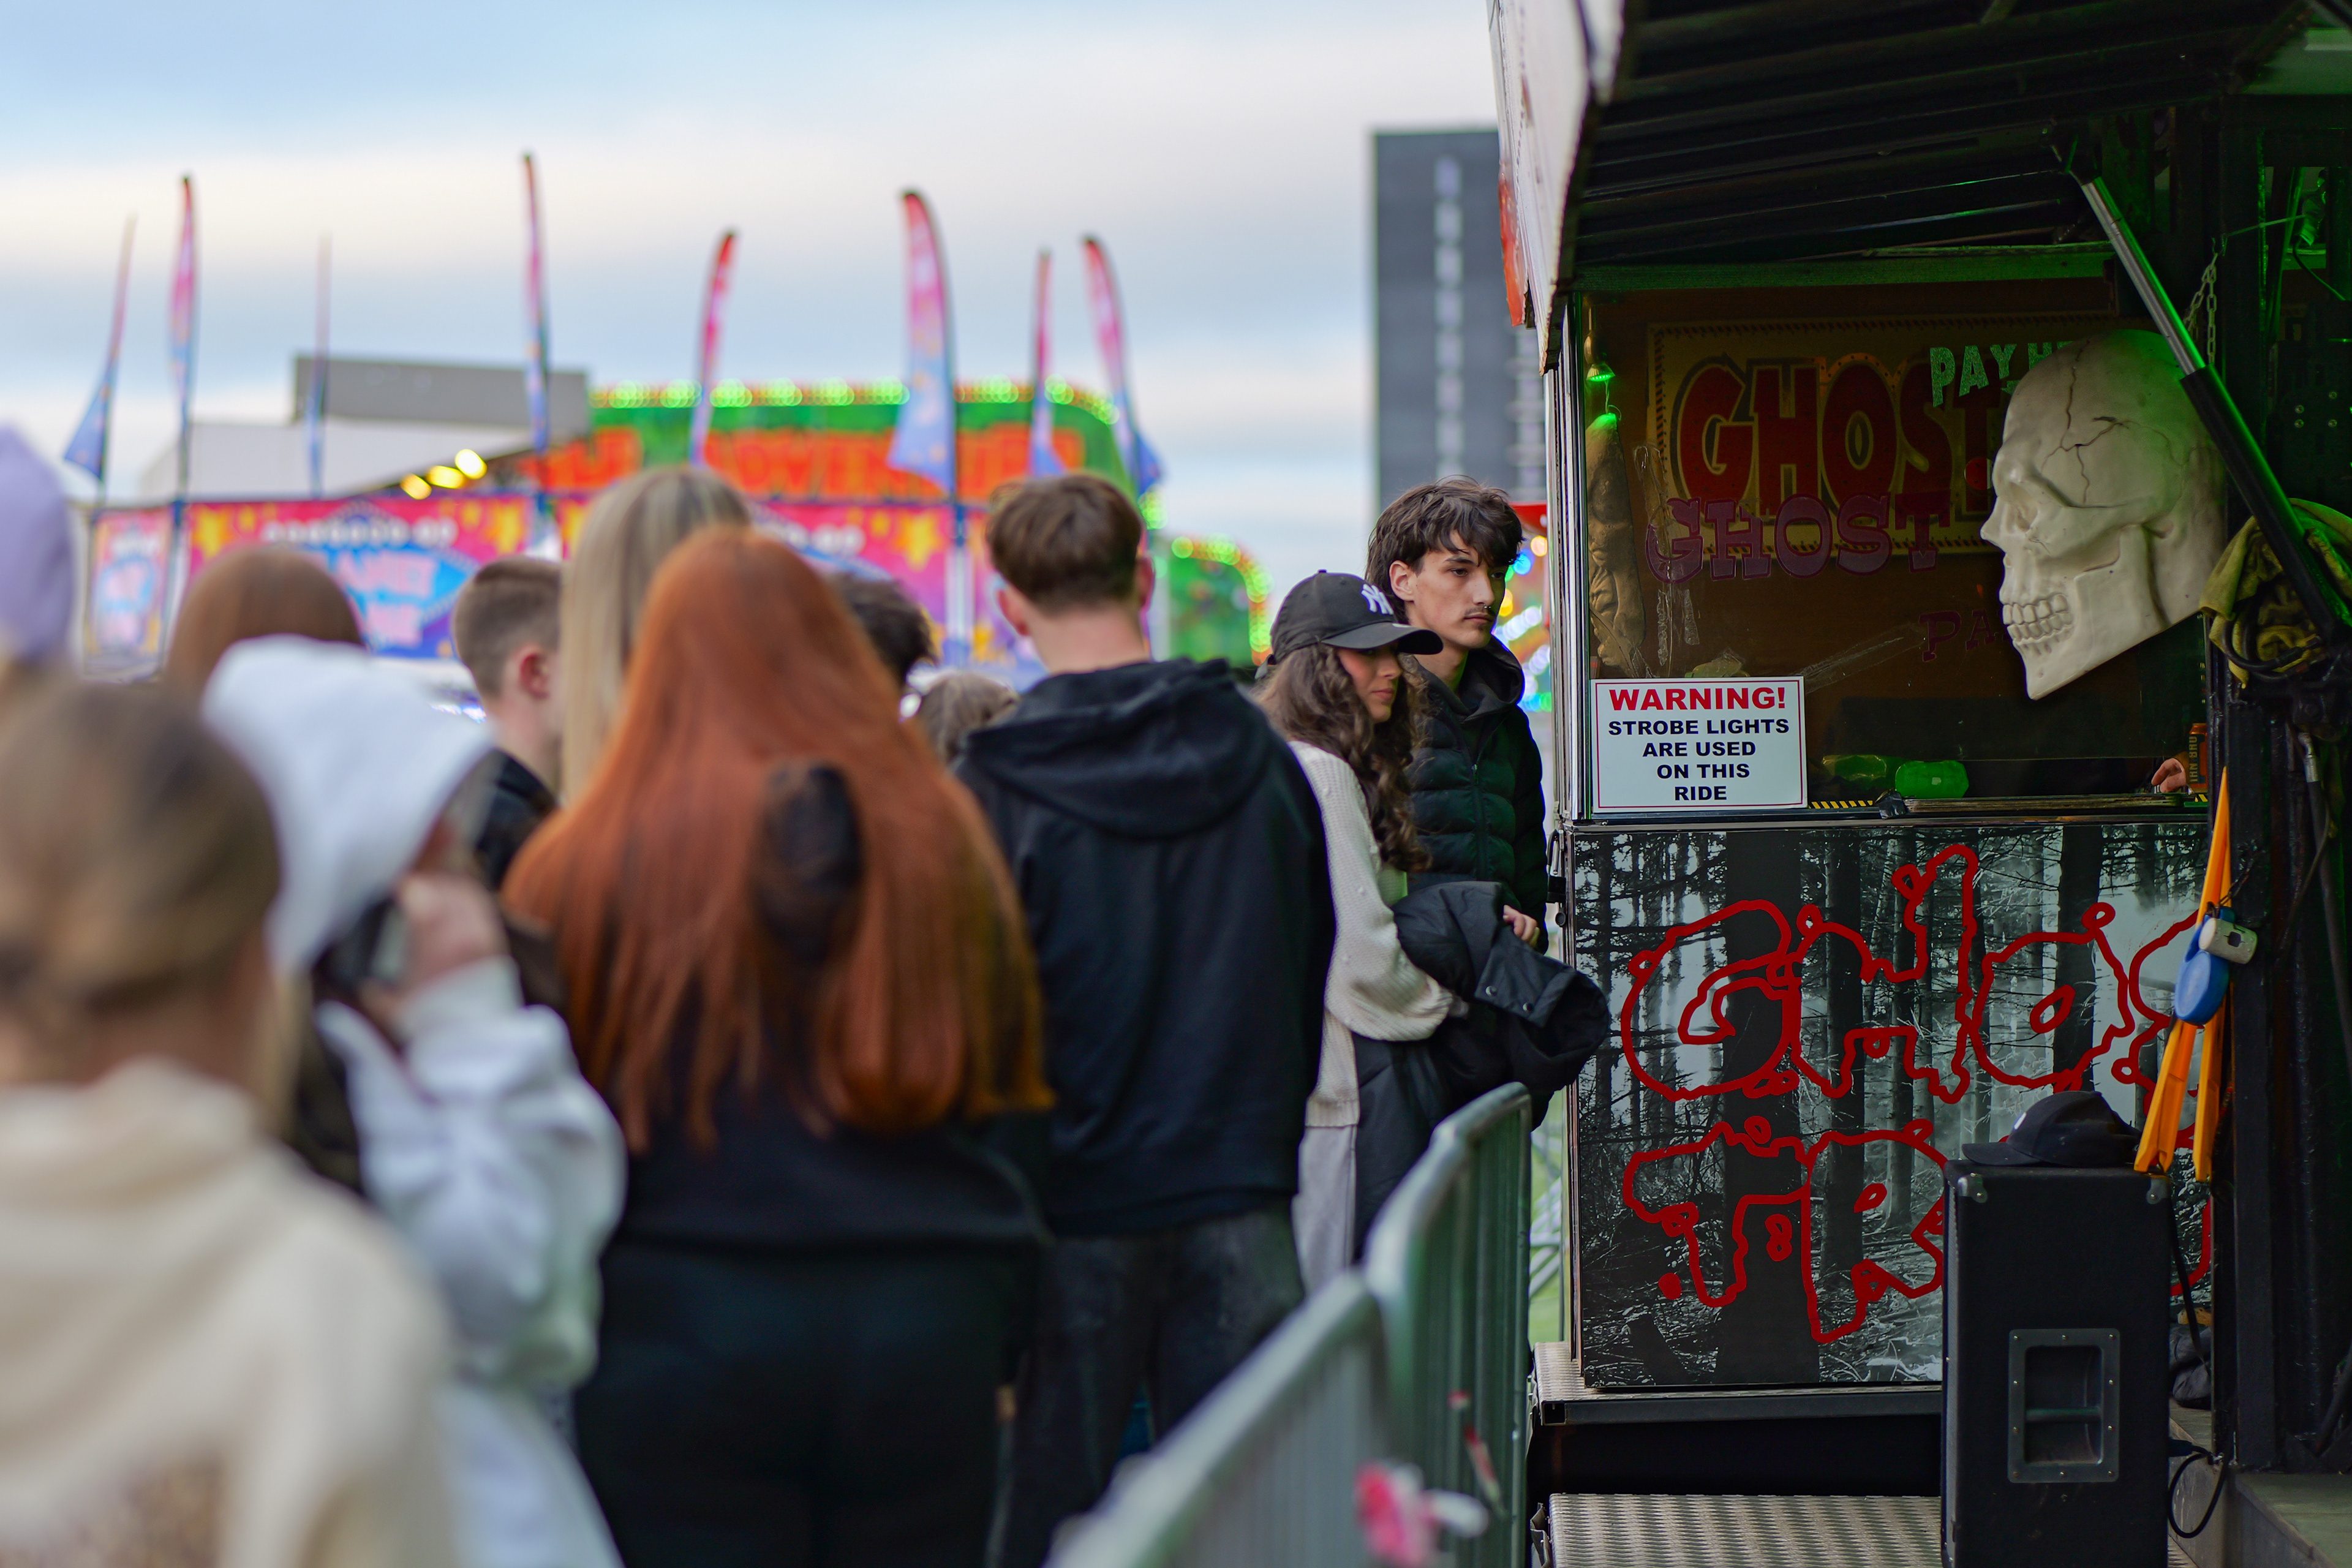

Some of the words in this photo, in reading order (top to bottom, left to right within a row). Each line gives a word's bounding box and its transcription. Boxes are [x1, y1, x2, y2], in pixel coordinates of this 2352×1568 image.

[1930, 344, 2018, 408] PAY
[1645, 492, 1951, 583] GHOST
[1361, 584, 1394, 615] NY
[1609, 687, 1786, 710] WARNING!
[1608, 720, 1699, 736] STROBE
[1707, 719, 1789, 734] LIGHTS
[1643, 742, 1688, 757] ARE
[1696, 742, 1756, 756] USED
[1657, 764, 1689, 779] ON
[1697, 763, 1751, 778] THIS
[1675, 786, 1727, 801] RIDE
